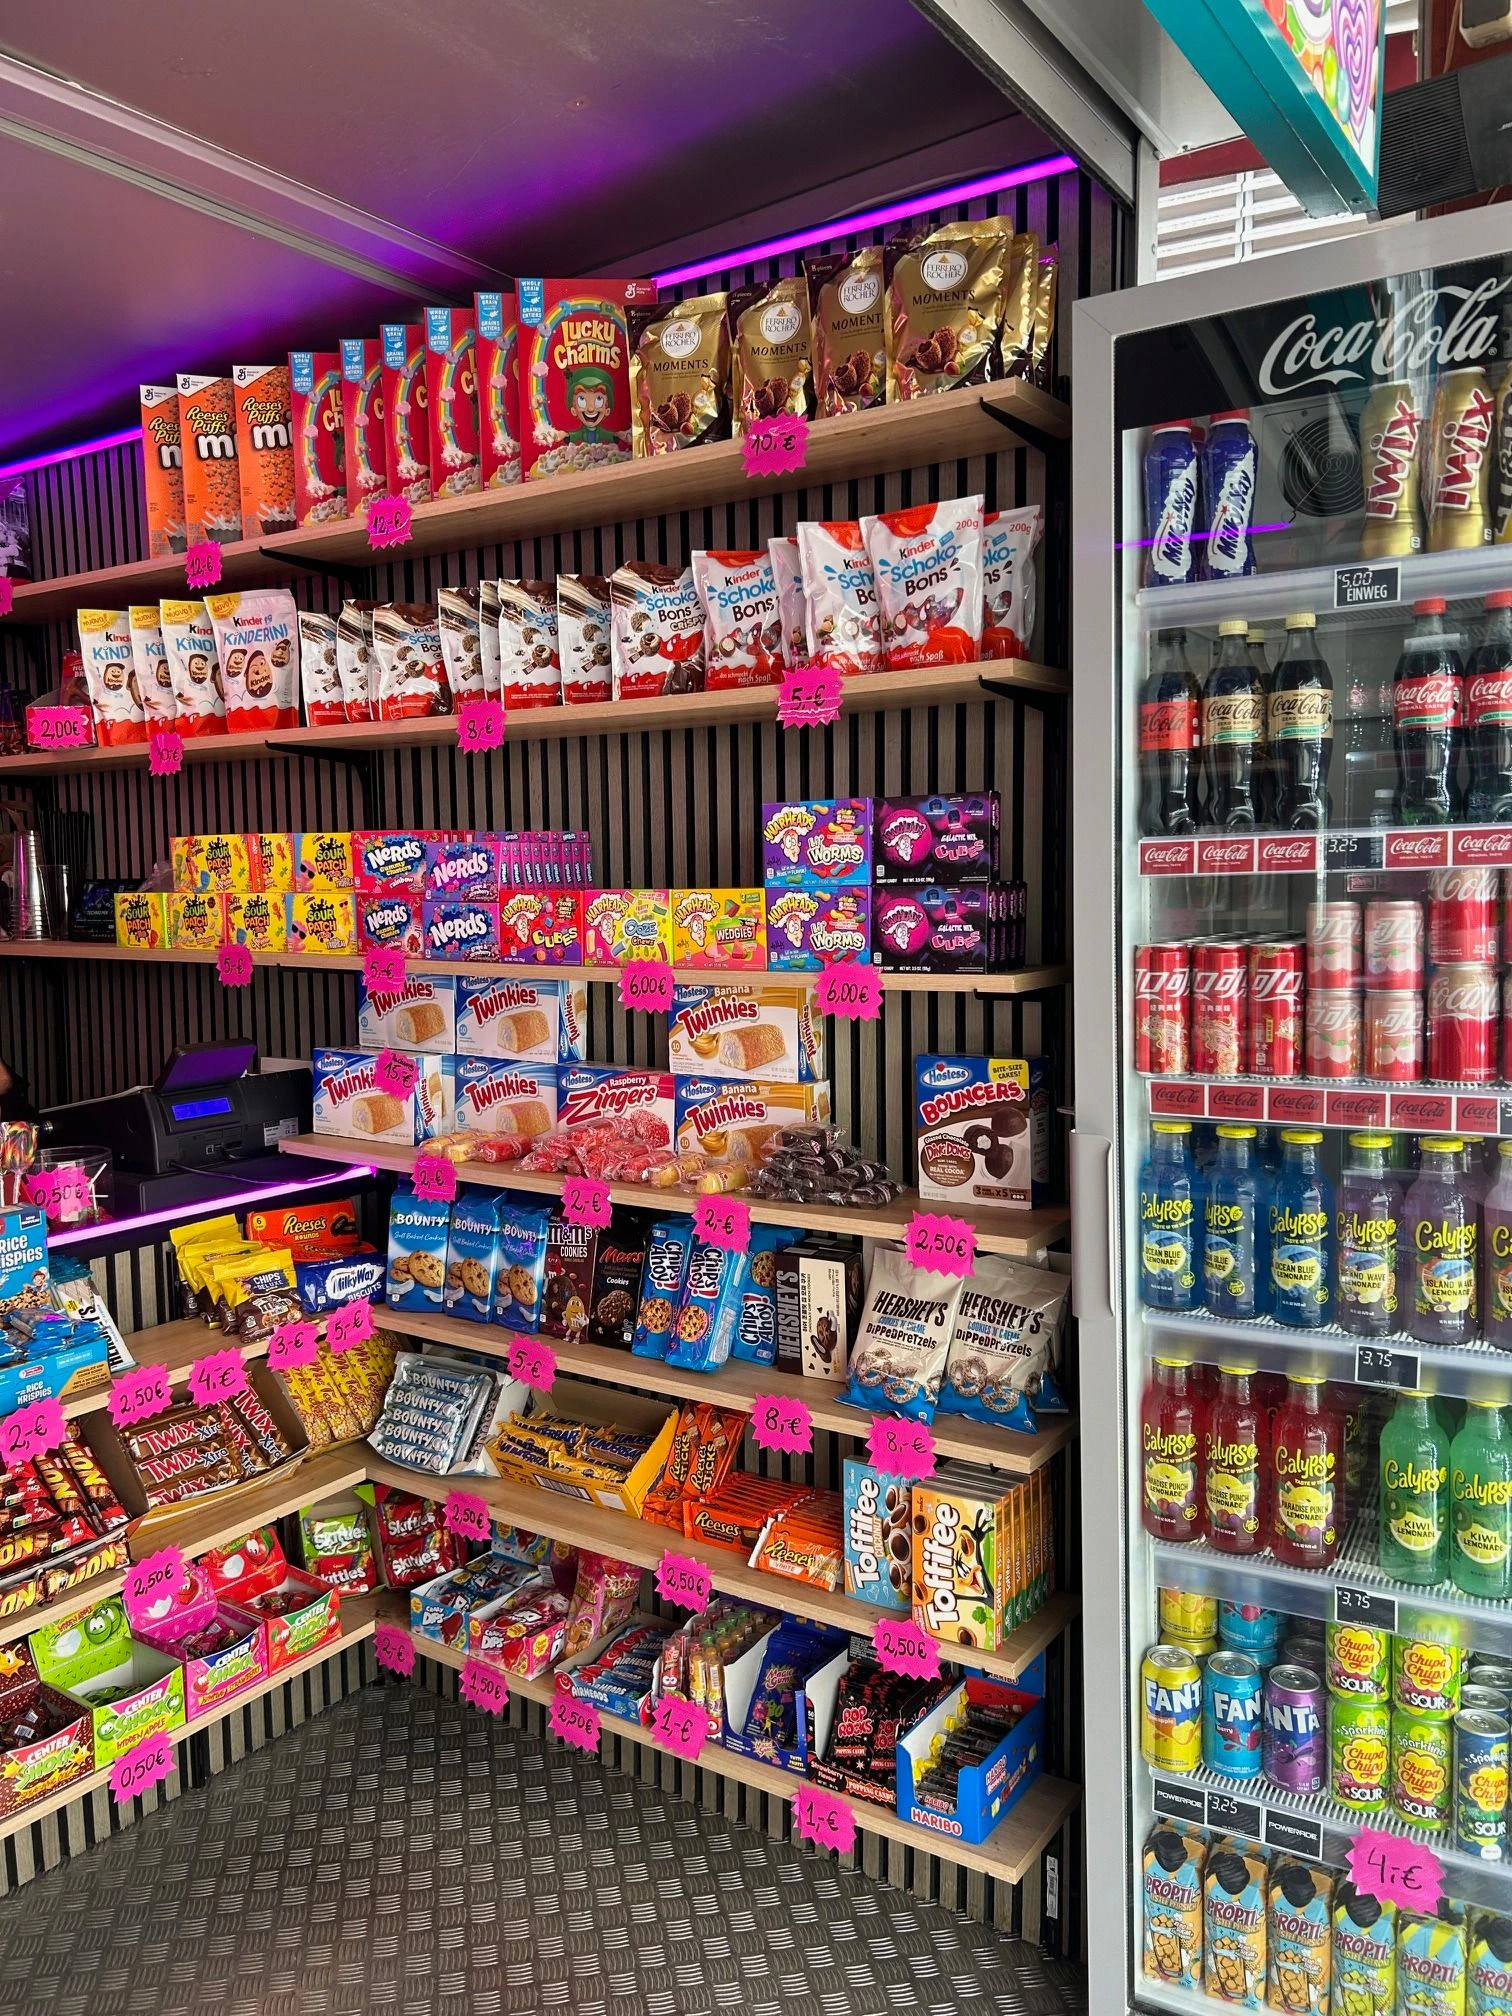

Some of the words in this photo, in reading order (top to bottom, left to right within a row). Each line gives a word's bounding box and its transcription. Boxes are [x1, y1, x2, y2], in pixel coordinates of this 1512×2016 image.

[926, 263, 962, 272] FERRERO
[926, 270, 962, 279] ROCHER
[912, 290, 975, 305] MOMENTS
[831, 313, 884, 331] MOMENT
[561, 320, 616, 347] Lucky
[1259, 276, 1512, 395] Coca-Cola
[554, 344, 621, 369] Charms
[751, 342, 807, 356] MOMENTS
[653, 359, 709, 372] MOMENTS
[247, 408, 281, 424] Puffs
[956, 519, 979, 532] 200g
[899, 537, 936, 560] Kinder
[843, 557, 871, 571] Kind
[725, 569, 760, 587] Kinder
[905, 566, 949, 597] Bons
[1347, 584, 1388, 601] EINWEG
[658, 606, 692, 622] Bons
[733, 599, 776, 622] Bons
[232, 616, 263, 628] Kinder
[41, 719, 80, 740] 2,00€
[764, 812, 815, 840] WARHEADS
[808, 845, 863, 864] WORMS
[934, 840, 984, 861] CUBES
[207, 859, 232, 869] PATCH
[532, 929, 578, 948] CUBES
[716, 926, 754, 942] WEDGIES
[931, 931, 981, 950] CUBES
[630, 976, 667, 995] 6,00€
[678, 987, 707, 999] Hostess
[714, 986, 749, 997] Banana
[468, 986, 536, 1025] Twinkies
[677, 997, 757, 1039] Twinkies
[672, 1042, 680, 1050] 10
[929, 1069, 967, 1083] Hostess
[992, 1064, 1024, 1074] BITE-SIZE
[998, 1071, 1021, 1080] CAKES!
[323, 1067, 374, 1105] Twinki
[610, 1076, 647, 1089] Raspberry
[465, 1073, 536, 1112] Twinkies
[566, 1084, 657, 1127] Zingers
[920, 1081, 1022, 1125] BOUNCERS
[687, 1096, 765, 1138] Twinkies
[284, 1214, 327, 1236] Reese's
[397, 1214, 445, 1227] BOUNTY
[455, 1219, 492, 1236] BOUNTY
[295, 1232, 319, 1241] ROUNDS
[504, 1224, 538, 1242] BOUNTY
[561, 1247, 588, 1258] COOKIES
[915, 1229, 967, 1258] 2,50€
[600, 1246, 643, 1264] Mars
[664, 1242, 683, 1282] Chips
[1275, 1263, 1294, 1273] OCEAN
[1296, 1264, 1315, 1274] BLUE
[253, 1272, 281, 1285] CHIPS
[257, 1279, 284, 1291] DELUXE
[607, 1276, 629, 1286] Cookies
[1426, 1279, 1454, 1289] ISLAND
[1457, 1279, 1473, 1288] WAVE
[777, 1270, 800, 1360] HERSHEY'S
[872, 1290, 948, 1327] HERSHEY'S
[959, 1291, 1044, 1335] HERSHEY'S
[878, 1316, 899, 1327] COOKIES
[26, 1381, 43, 1393] RICE
[17, 1388, 52, 1405] KRISPIES
[120, 1381, 164, 1414] 2,50€
[140, 1447, 200, 1483] Twix
[200, 1448, 228, 1467] Xtra
[702, 1443, 716, 1493] STICKS
[1385, 1460, 1447, 1494] Calypso
[1169, 1482, 1189, 1492] PUNCH
[1282, 1501, 1308, 1513] PARADISE
[1309, 1504, 1329, 1514] PUNCH
[388, 1512, 436, 1536] Skittles
[695, 1511, 741, 1536] Reese's
[1404, 1520, 1430, 1531] KIWI
[850, 1477, 881, 1589] Toffifee
[873, 1513, 883, 1558] COCONUT
[1470, 1532, 1498, 1544] KIWI
[1464, 1538, 1504, 1552] LEMONADE
[775, 1562, 796, 1572] WHITE
[922, 1503, 960, 1631] Toffifee
[134, 1563, 173, 1597] 2,50€
[666, 1567, 705, 1597] 2,50€
[1339, 1634, 1375, 1651] Chupa
[1337, 1647, 1374, 1668] Chups
[765, 1675, 790, 1690] Gum
[1340, 1676, 1374, 1693] SOUR
[571, 1686, 608, 1703] AIRHEADS
[1146, 1679, 1201, 1713] FANT
[1411, 1693, 1446, 1709] SOUR
[842, 1706, 867, 1722] POP
[1214, 1690, 1261, 1722] FAN
[143, 1717, 167, 1739] APPLE
[838, 1718, 873, 1738] ROCKS
[27, 1735, 70, 1764] CENTER
[120, 1748, 165, 1788] 0,50€
[810, 1761, 843, 1780] Strawberry
[1157, 1791, 1203, 1809] POWERADE
[1350, 1787, 1383, 1800] SOUR
[1403, 1800, 1438, 1819] SOUR
[911, 1809, 962, 1836] HARIBO
[1268, 1820, 1318, 1841] POWERADE
